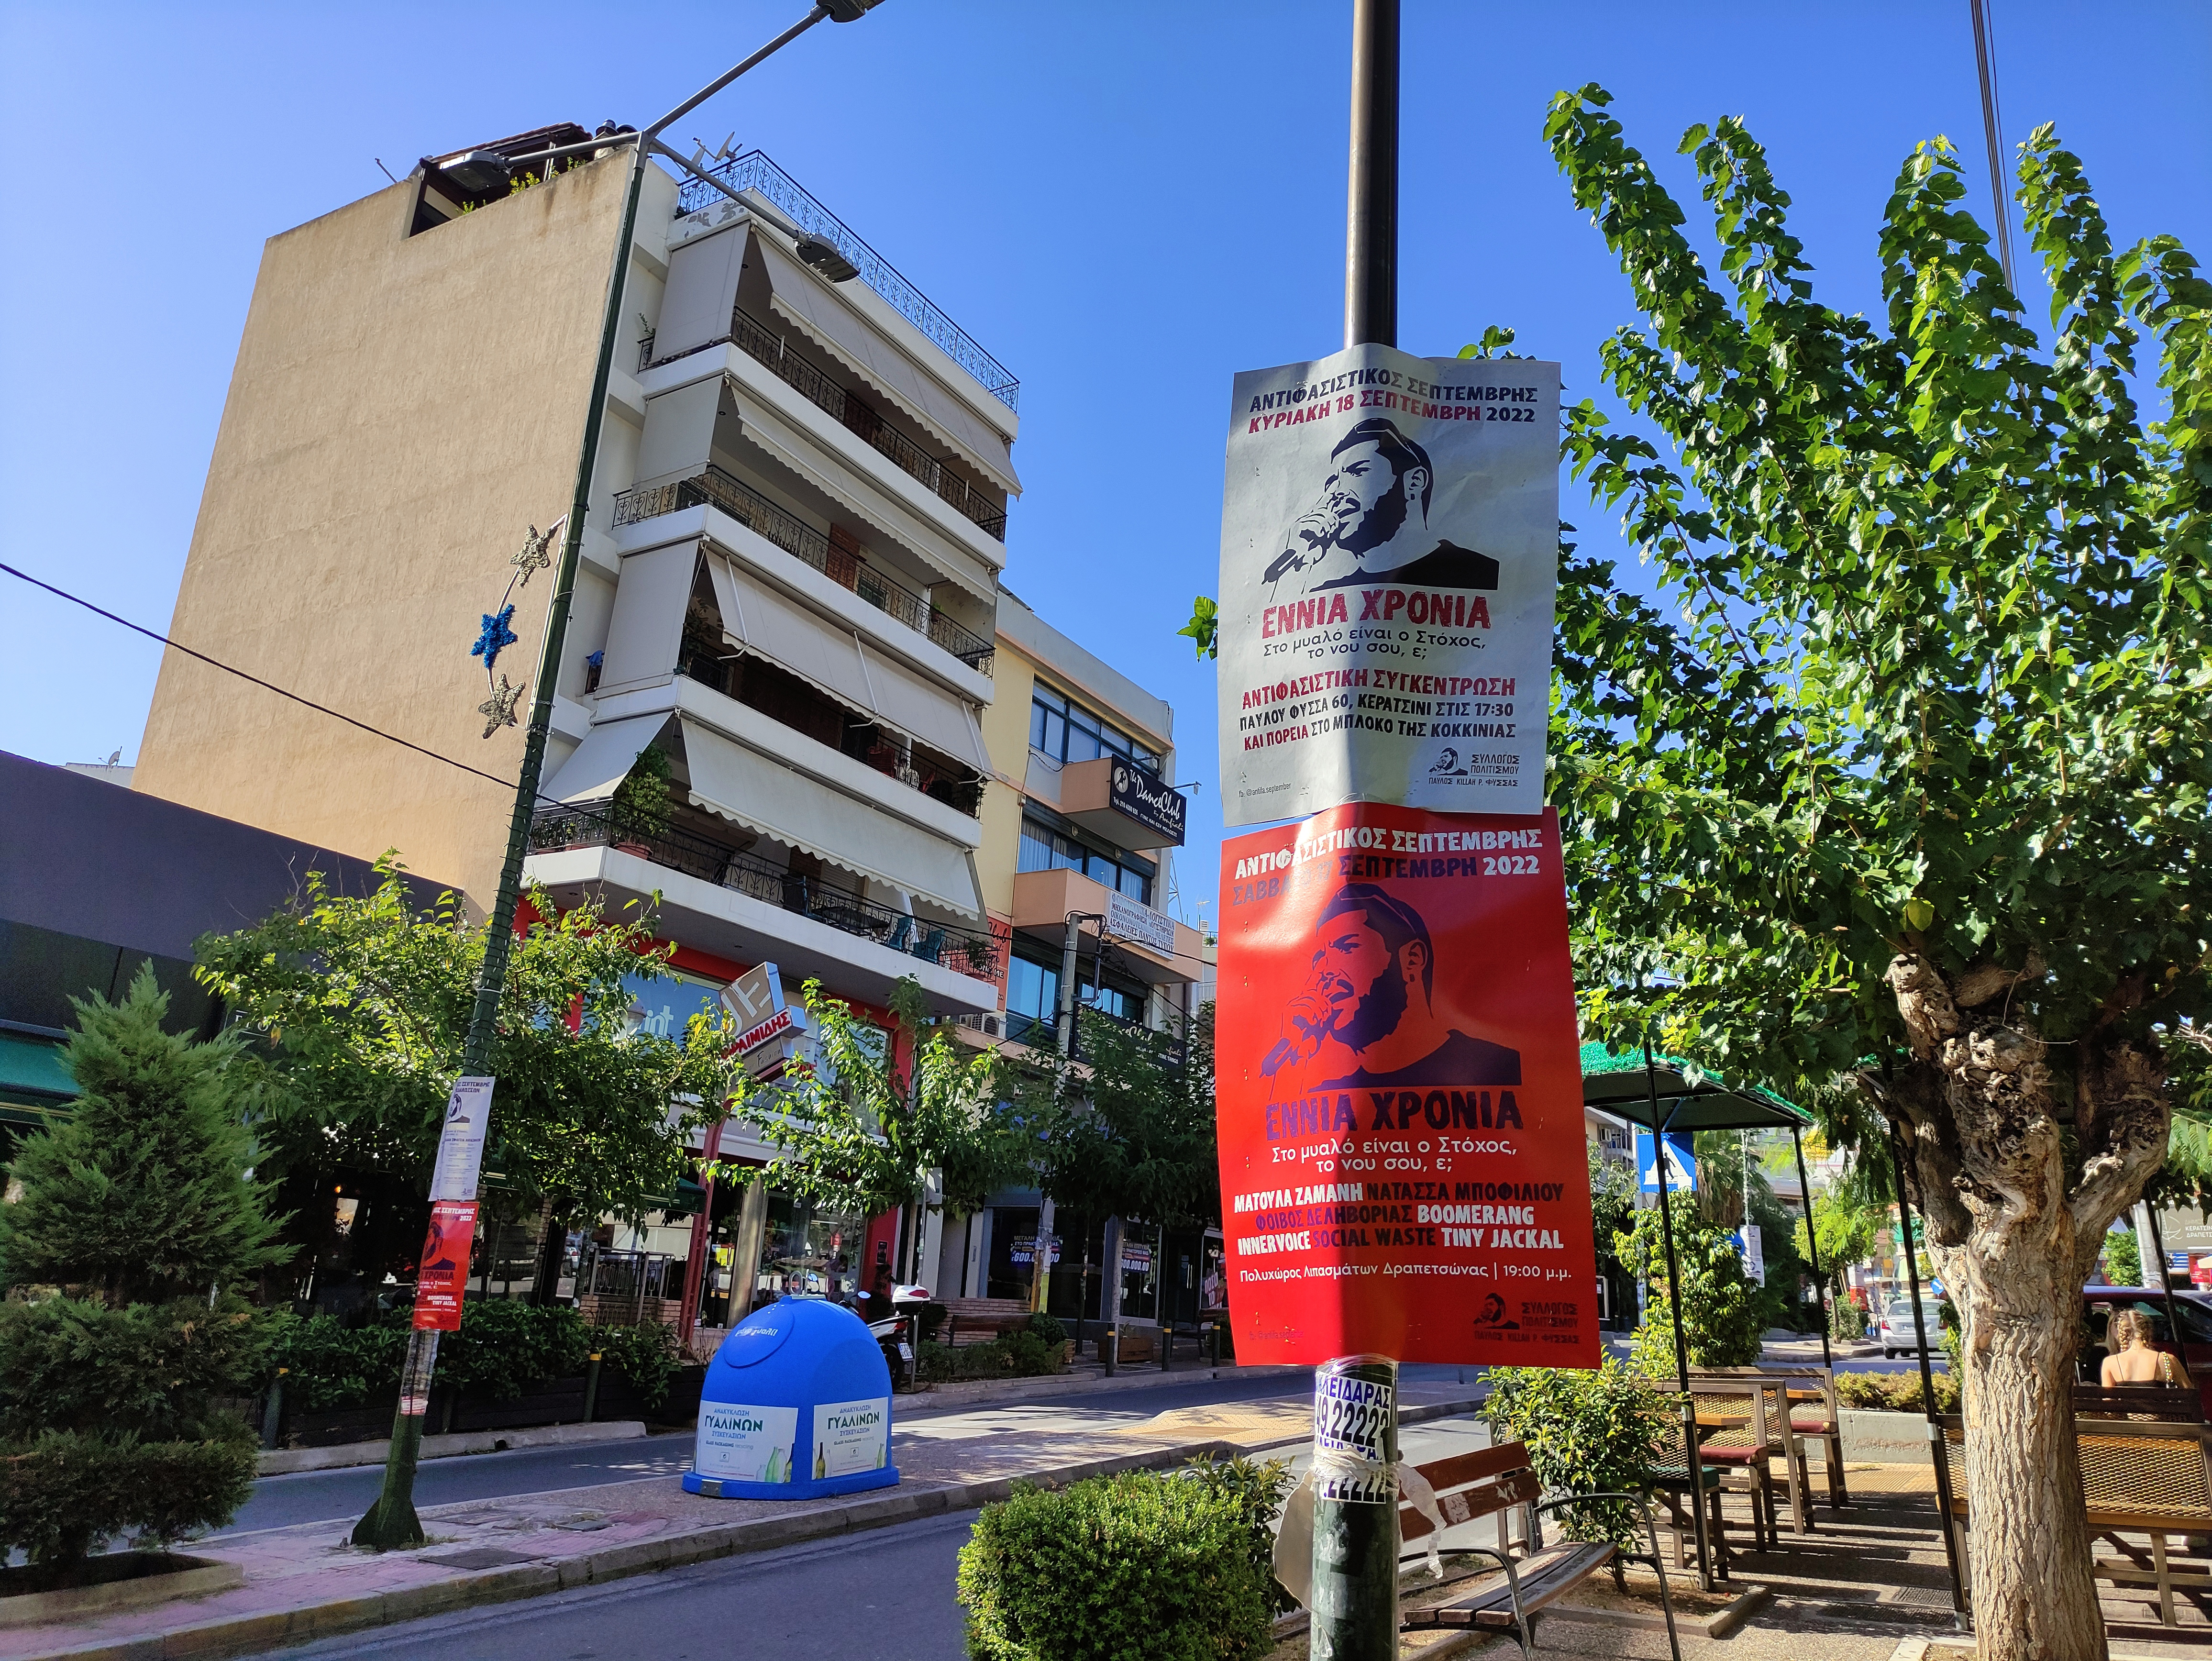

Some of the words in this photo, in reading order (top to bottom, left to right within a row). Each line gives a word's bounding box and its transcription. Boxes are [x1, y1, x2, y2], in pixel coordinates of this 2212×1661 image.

[1250, 368, 1403, 412] ΑΝΤΙΦΑΣΙΣΤΙΚΟΣ
[1407, 376, 1538, 402] ΣΕΠΤΕΜΒΡΗΣ
[1248, 400, 1331, 434] ΚΥΡΙΑΚΗ
[1336, 394, 1354, 413] 18
[1360, 389, 1481, 421] ΣΕΠΤΕΜΒΡΗ
[1486, 407, 1536, 422] 2022
[1262, 593, 1348, 639] ΕΝΝΙΑ
[1359, 589, 1491, 629] ΧΡΟΝΙΑ
[1263, 642, 1288, 656] Στο
[1293, 628, 1342, 653] μυαλό
[1349, 626, 1392, 640] είναι
[1398, 631, 1409, 641] ο
[1416, 630, 1486, 649] Στόχος,
[1308, 648, 1324, 658] το
[1330, 643, 1359, 654] νου
[1367, 642, 1405, 657] σου,
[1412, 647, 1427, 660] ε;
[1242, 668, 1368, 710] ΑΝΤΙΦΑΣΙΣΤΙΚΗ
[1373, 669, 1515, 696] ΣΥΓΚΕΝΤΡΩΣΗ
[1240, 707, 1285, 731] ΠΑΥΛΟΥ
[1290, 697, 1328, 720] ΦΥΣΣΑ
[1332, 694, 1353, 710] 60,
[1357, 694, 1431, 716] ΚΕΡΑΤΣΙΝΙ
[1435, 702, 1471, 717] ΣΤΙΣ
[1474, 703, 1514, 717] 17:30
[1244, 734, 1264, 751] ΚΑΙ
[1266, 724, 1309, 746] ΠΟΡΕΙΑ
[1311, 718, 1330, 736] ΣΤΟ
[1333, 714, 1393, 733] ΜΠΛΟΚΟ
[1398, 720, 1427, 737] ΤΗΣ
[1431, 723, 1516, 738] ΚΟΚΚΙΝΙΑΣ
[1471, 753, 1520, 764] ΣΥΛΛΟΓΟΣ
[1471, 765, 1519, 774] ΠΟΛΙΤΙΣΜΟΥ
[1246, 782, 1291, 796] @antifa.september
[1485, 778, 1518, 786] ΦΥΣΣΑΣ
[1235, 827, 1386, 879] ΑΝΤΙΦΑΣΙΣΤΙΚΟΣ
[1392, 829, 1543, 853] ΣΕΠΤΕΜΒΡΗΣ
[1233, 868, 1311, 906] ΣΑΒΒΑΟ
[1316, 861, 1333, 881] 17
[1338, 854, 1477, 878] ΣΕΠΤΕΜΒΡΗ
[1483, 855, 1540, 875] 2022
[1266, 1094, 1358, 1141] ΕΝΝΙΑ
[1369, 1090, 1523, 1130] ΧΡΟΝΙΑ
[1272, 1147, 1296, 1163] Στο
[1301, 1138, 1355, 1163] μυαλό
[1363, 1138, 1409, 1153] είναι
[1418, 1141, 1430, 1153] ο
[1438, 1137, 1517, 1155] Στόχος,
[1316, 1160, 1334, 1172] το
[1341, 1159, 1376, 1170] νου
[1384, 1158, 1427, 1172] σου,
[1437, 1158, 1452, 1172] ε;
[1234, 1188, 1293, 1213] ΜΑΤΟΥΛΑ
[1295, 1182, 1363, 1205] ΖΑΜΑΝΗ
[1367, 1182, 1449, 1200] ΝΑΤΑΣΣΑ
[1455, 1182, 1564, 1201] ΜΠΟΦΙΛΙΟΥ
[1256, 1209, 1304, 1231] ΦΟΙΒΟΣ
[1307, 1205, 1412, 1226] ΔΕΛΗΒΟΡΙΑΣ
[1417, 1204, 1534, 1225] BOOMERANG
[1238, 1230, 1311, 1255] INNERVOICE
[1313, 1229, 1370, 1248] SOCIAL
[1374, 1228, 1436, 1246] WASTE
[1441, 1228, 1484, 1247] TINY
[1491, 1229, 1564, 1249] JACKAL
[1240, 1267, 1302, 1283] Πολυχώρος
[1304, 1263, 1378, 1280] Λιπασμάτων
[1382, 1262, 1488, 1278] Δραπετσώνας
[1503, 1265, 1540, 1277] 19:00
[1546, 1269, 1572, 1281] μ.μ.
[1521, 1302, 1578, 1315] ΣΥΛΛΟΓΟΣ
[714, 1408, 750, 1416] ΑΝΑΚΥΚΛΩΣΗ
[828, 1412, 879, 1429] ΓΥΑΛΙΝΩΝ
[840, 1405, 871, 1414] ΑΝΑΚΥΚΛΩΣΗ
[705, 1415, 763, 1432] ΓΥΑΛΙΝΩΝ
[712, 1431, 746, 1439] ΣΥΣΚΕΥΑΣΙΩΝ
[840, 1427, 870, 1436] ΣΥΣΚΕΥΑΣΙΩΝ
